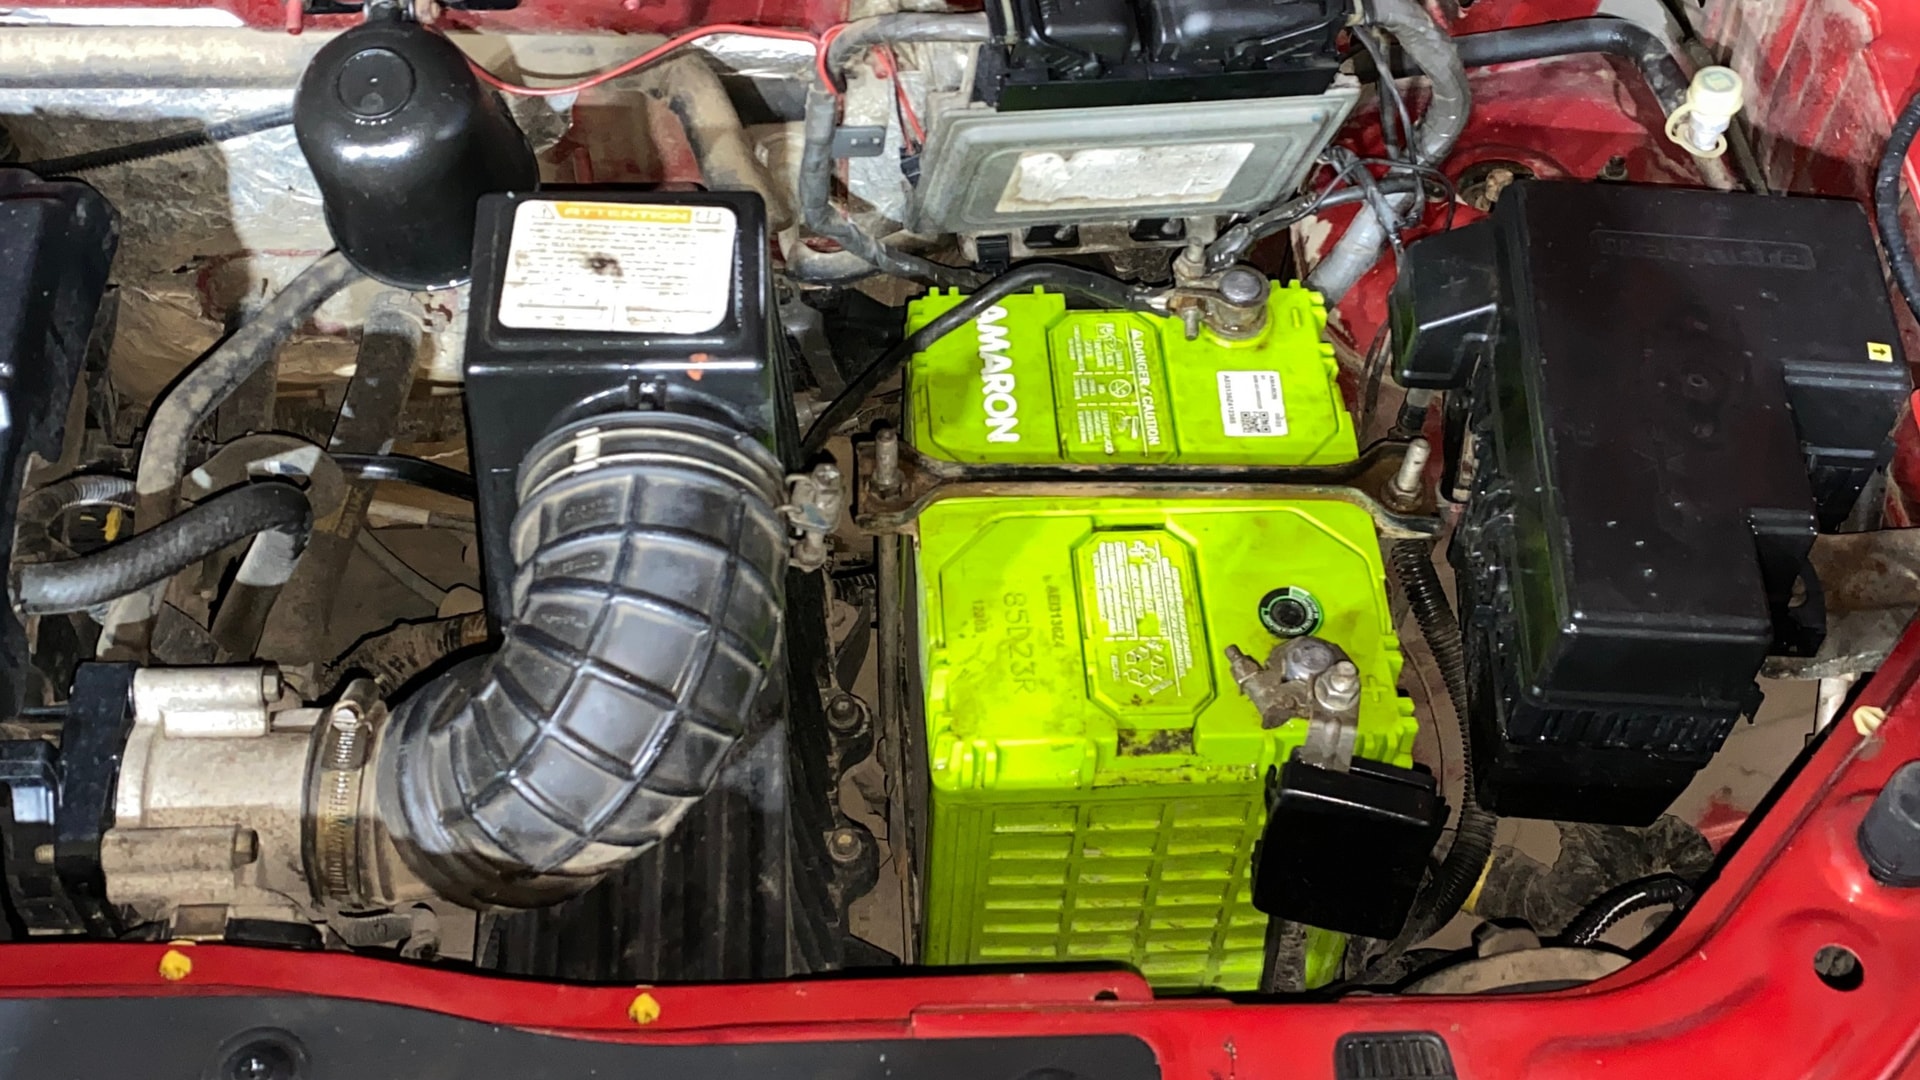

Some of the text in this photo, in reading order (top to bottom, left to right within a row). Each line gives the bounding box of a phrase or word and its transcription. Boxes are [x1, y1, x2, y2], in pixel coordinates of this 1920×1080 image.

[564, 206, 688, 221] ATTENTION
[976, 304, 1020, 443] AMARON
[1133, 340, 1151, 386] DANGER
[1142, 395, 1161, 446] CAUTION
[1003, 592, 1037, 694] 85D23R
